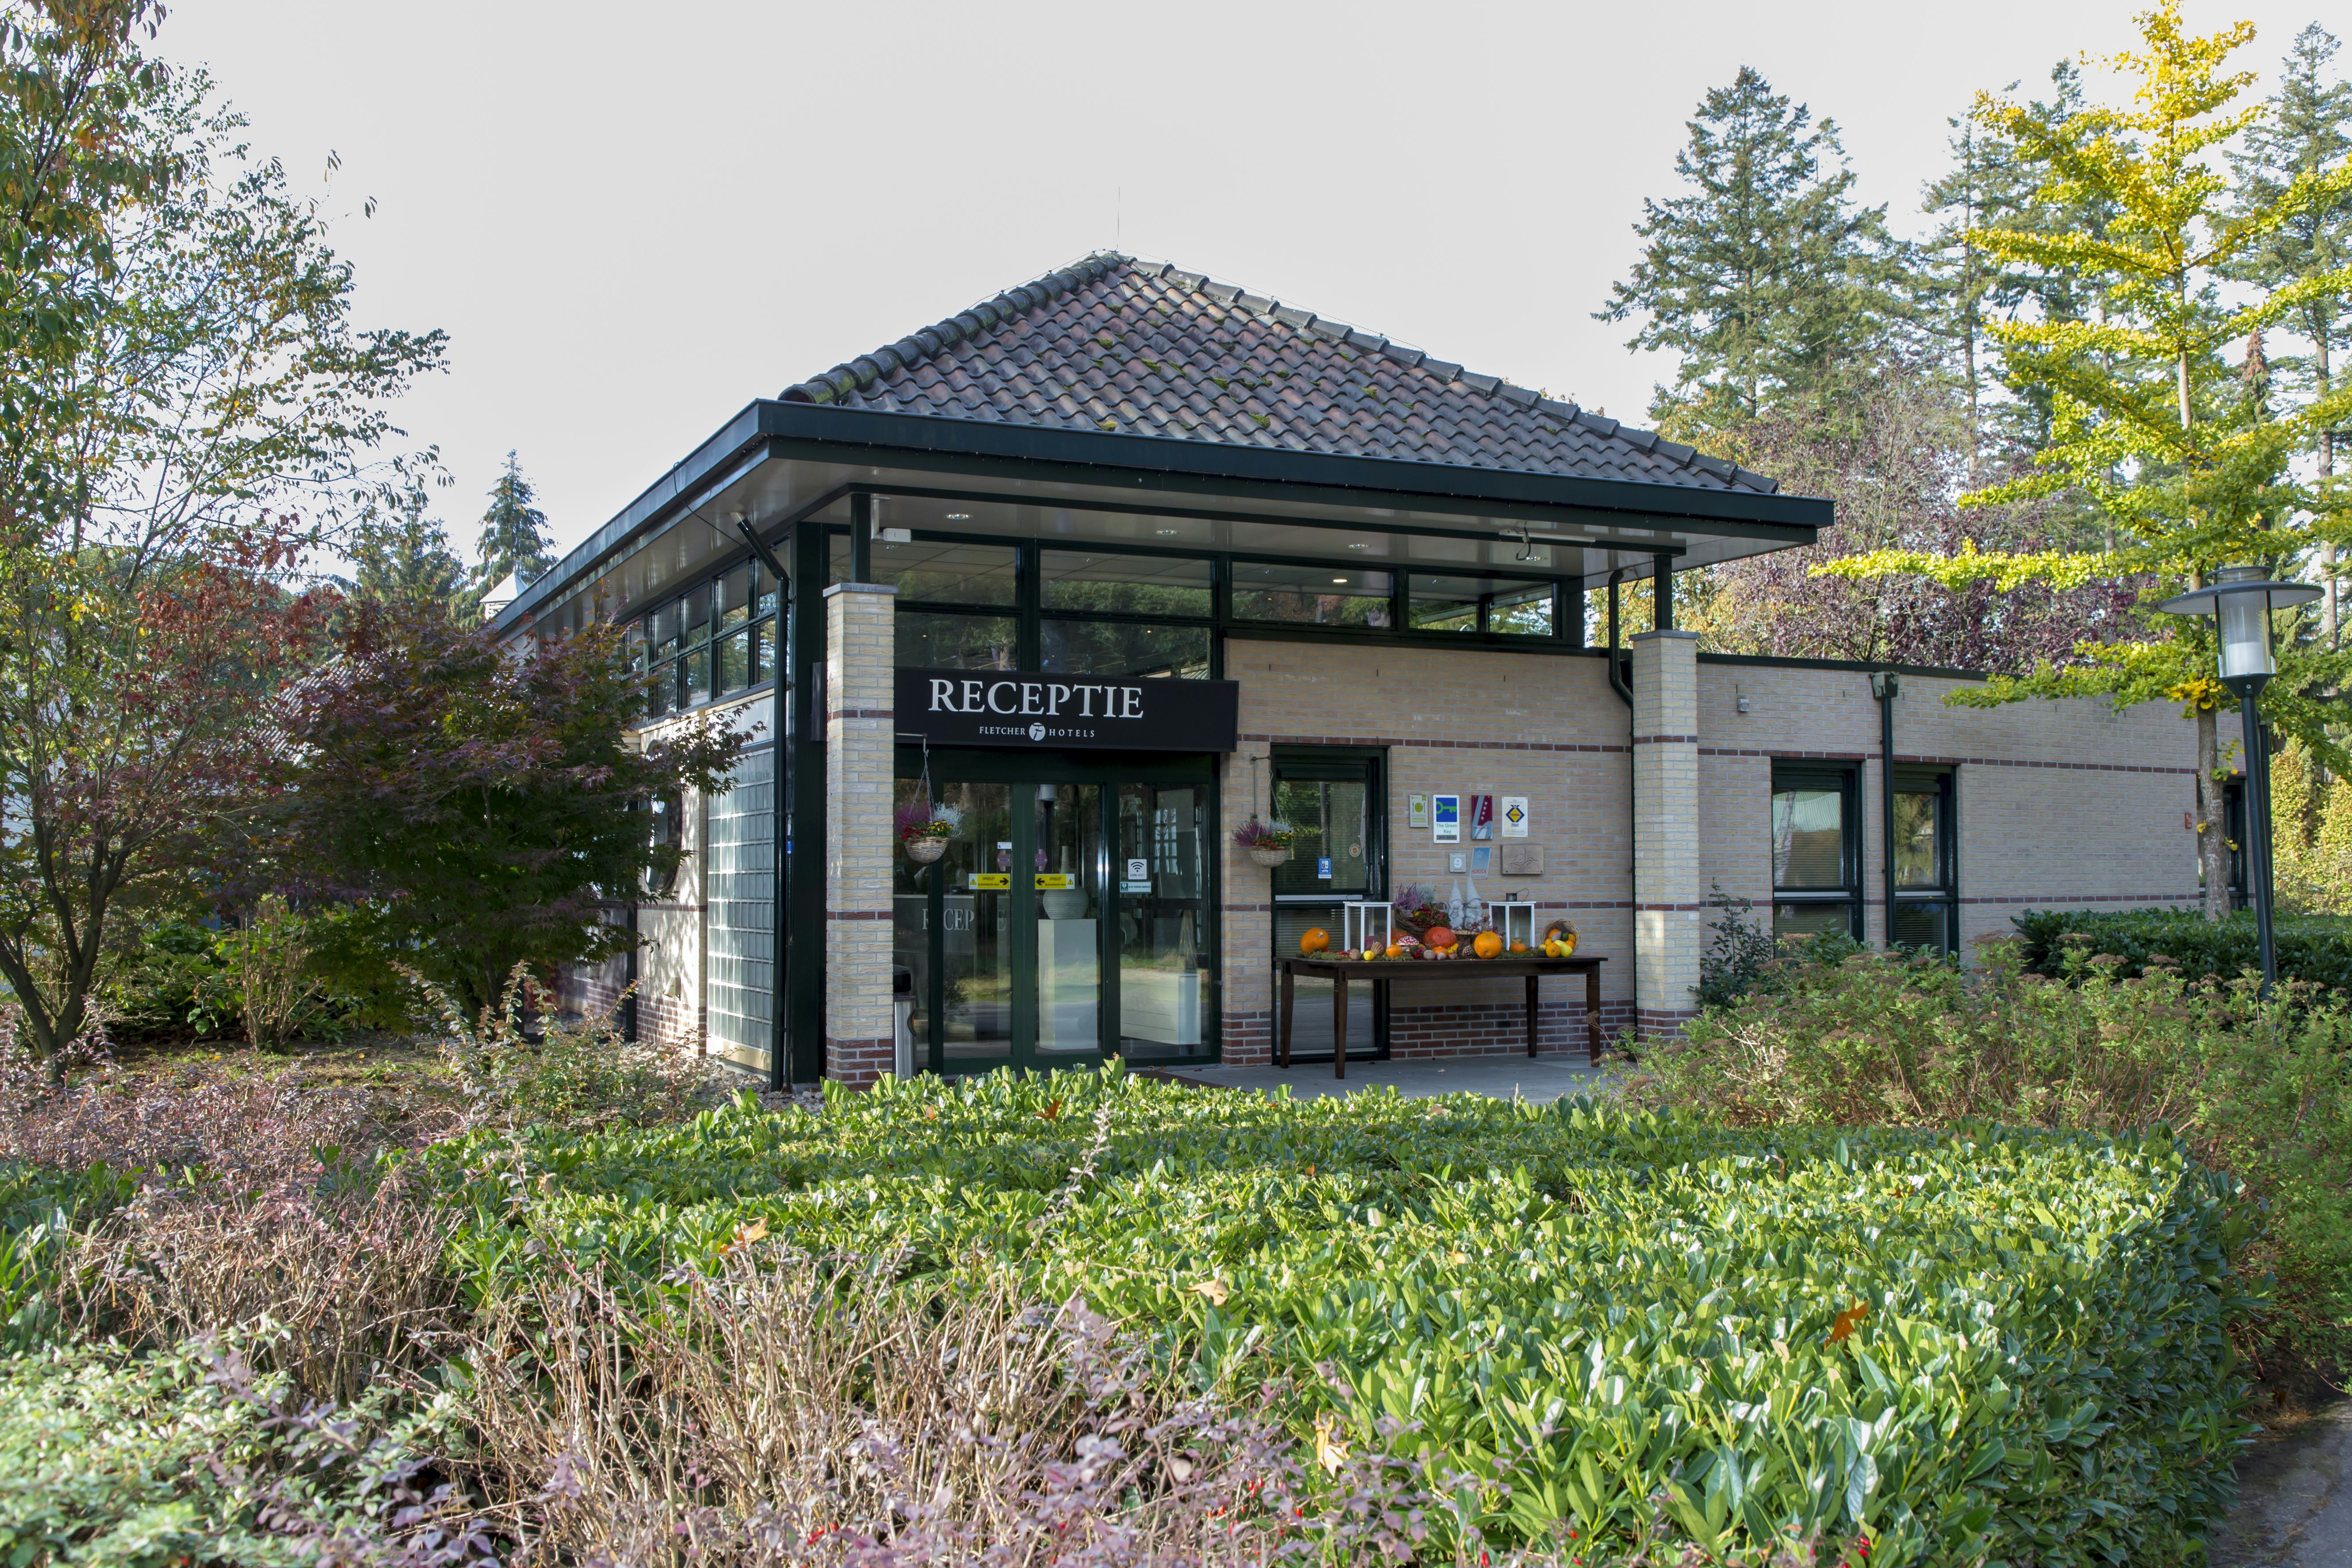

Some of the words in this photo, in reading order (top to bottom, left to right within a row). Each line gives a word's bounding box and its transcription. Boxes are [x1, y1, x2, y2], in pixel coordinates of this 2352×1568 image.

[928, 679, 1143, 718] RECEPTIE
[979, 726, 1026, 736] FLETCHER
[1049, 728, 1095, 738] HOTELS
